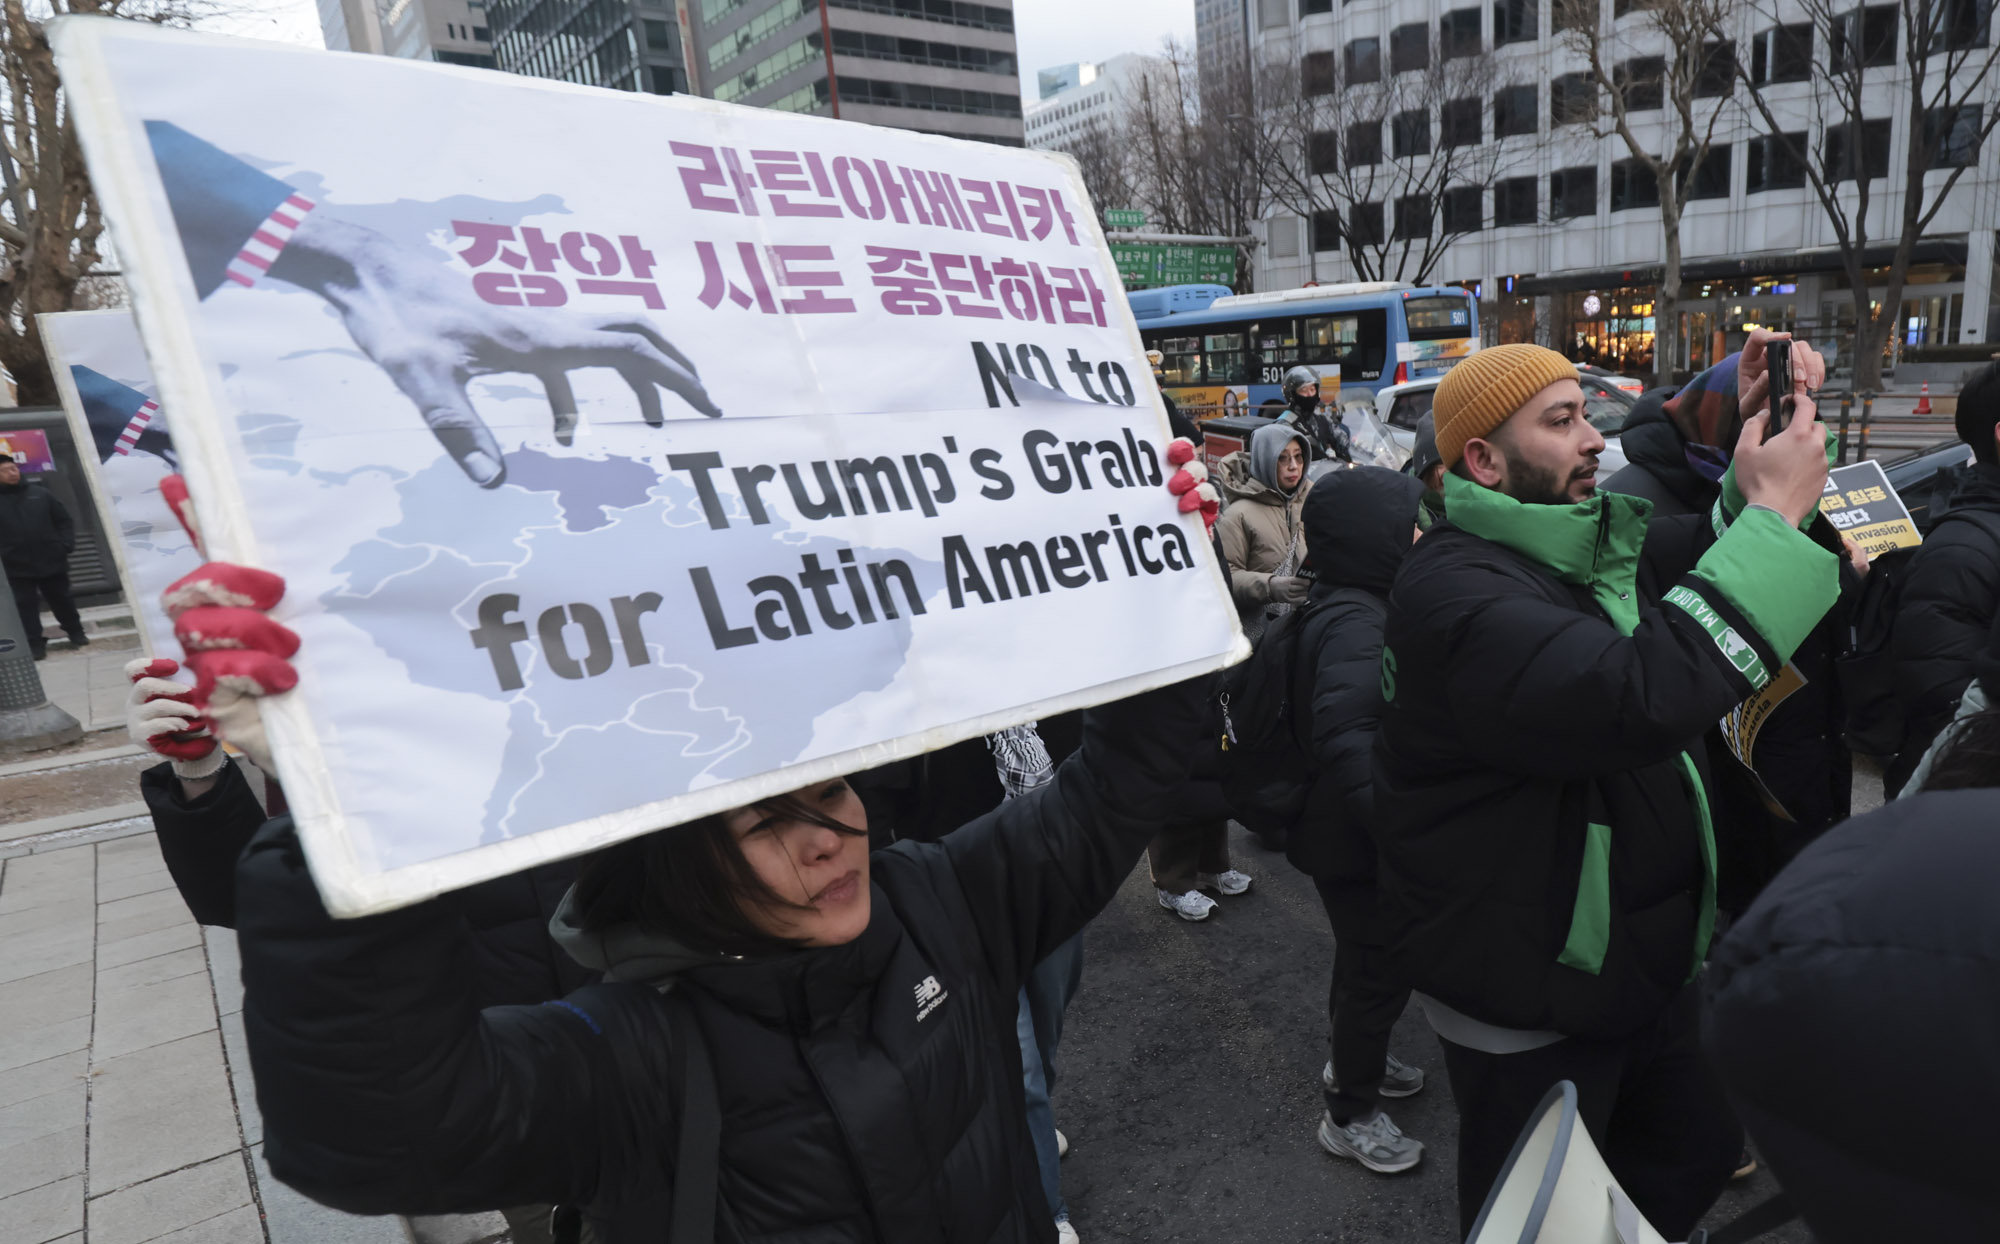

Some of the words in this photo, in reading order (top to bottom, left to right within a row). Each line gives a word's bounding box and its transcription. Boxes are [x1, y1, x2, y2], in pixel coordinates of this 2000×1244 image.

[668, 139, 1081, 247] 라틴아메리카
[450, 219, 667, 311] 장악
[694, 240, 857, 315] 시도
[864, 244, 1108, 328] 중단하라
[1200, 253, 1217, 264] 시청
[1452, 311, 1466, 324] 501
[1066, 347, 1137, 407] to
[1262, 366, 1286, 383] 501
[666, 436, 1015, 531] Trump's
[1022, 427, 1164, 495] Grab
[1846, 485, 1887, 506] 침공
[1851, 523, 1907, 542] invasion
[469, 591, 664, 692] for
[688, 547, 928, 651] Latin
[942, 513, 1195, 610] America
[1673, 589, 1719, 628] MAJOR
[916, 1006, 930, 1023] new
